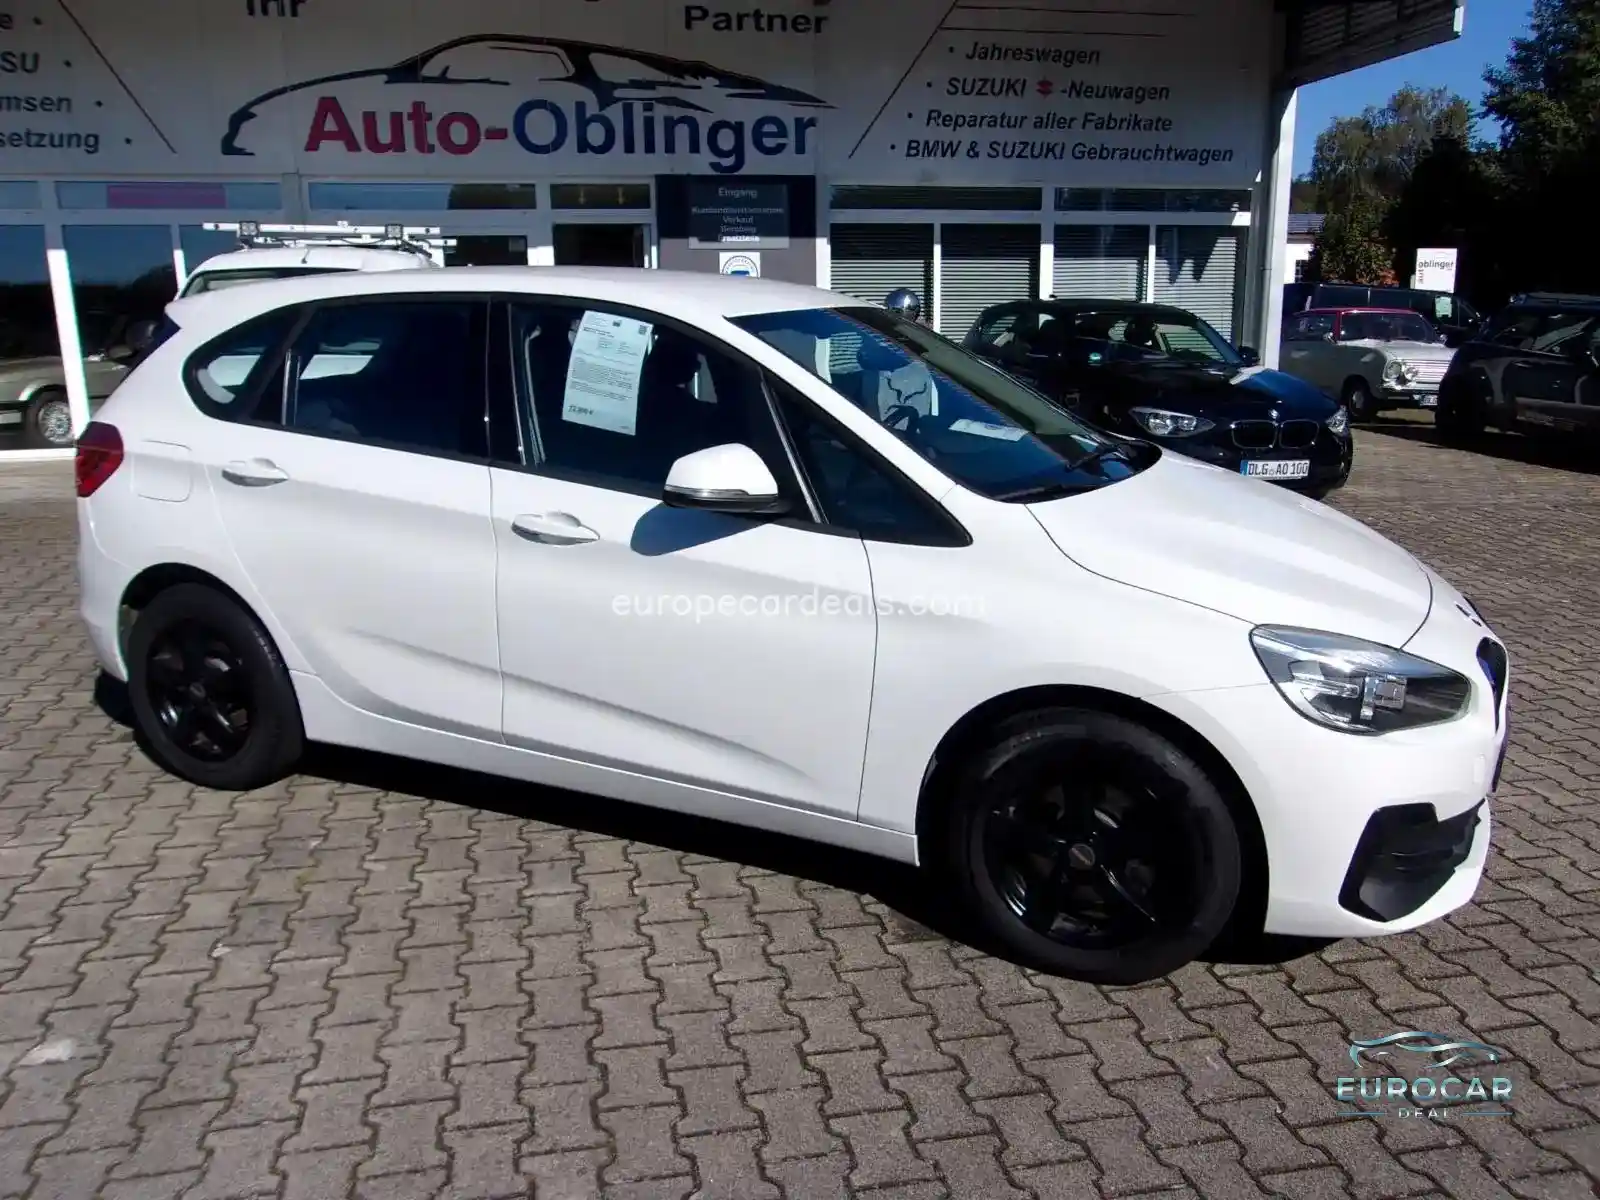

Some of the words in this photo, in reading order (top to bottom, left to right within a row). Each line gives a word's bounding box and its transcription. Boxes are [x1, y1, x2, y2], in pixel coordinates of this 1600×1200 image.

[684, 5, 829, 34] Partner
[965, 41, 1101, 67] Jahreswagen
[945, 77, 1027, 98] SUZUKI
[926, 109, 1028, 133] Reparatur
[1033, 112, 1077, 131] aller
[1082, 112, 1173, 133] Fabrikate
[304, 95, 818, 174] Auto-Oblinger
[905, 139, 963, 159] BMW
[966, 141, 981, 159] &
[986, 140, 1065, 160] SUZUKI
[1070, 141, 1234, 166] Gebrauchtwagen
[1248, 462, 1269, 476] DLG
